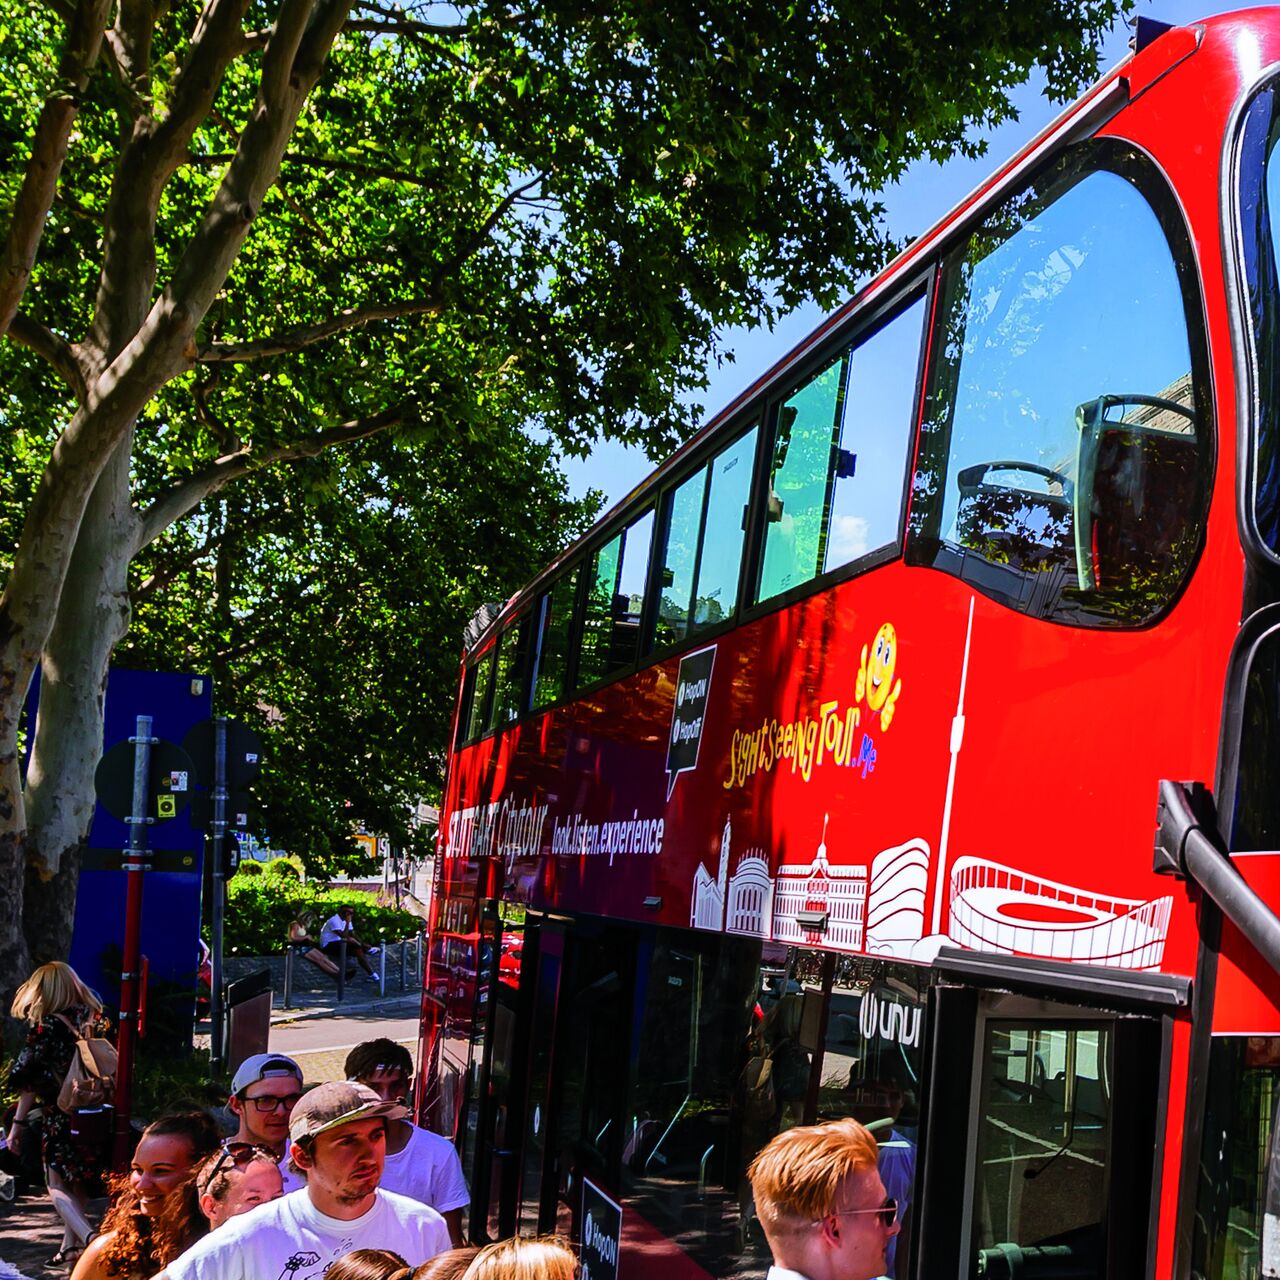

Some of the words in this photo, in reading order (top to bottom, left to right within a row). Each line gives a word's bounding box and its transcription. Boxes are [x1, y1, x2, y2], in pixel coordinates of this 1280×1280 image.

[445, 801, 500, 858] STUTTGART
[497, 792, 549, 876] Citytour
[592, 1221, 617, 1267] HopON
